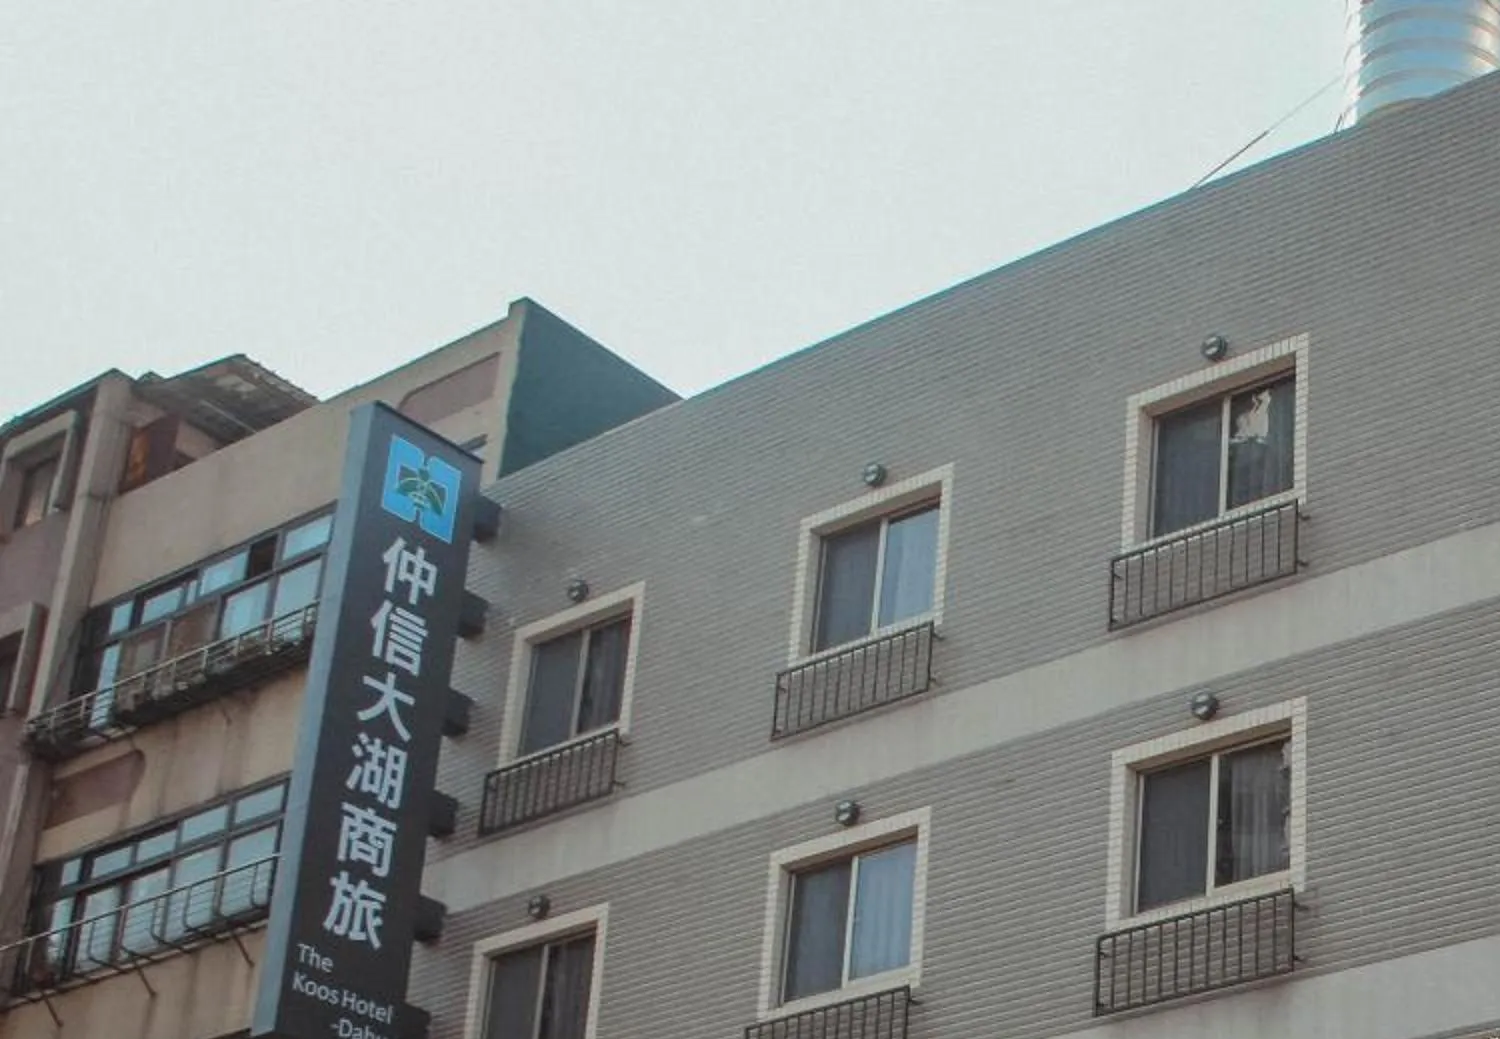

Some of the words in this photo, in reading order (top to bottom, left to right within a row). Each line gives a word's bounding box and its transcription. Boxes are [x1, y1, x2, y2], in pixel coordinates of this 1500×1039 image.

[323, 536, 437, 951] 仲信大湖商旅
[297, 943, 334, 973] The
